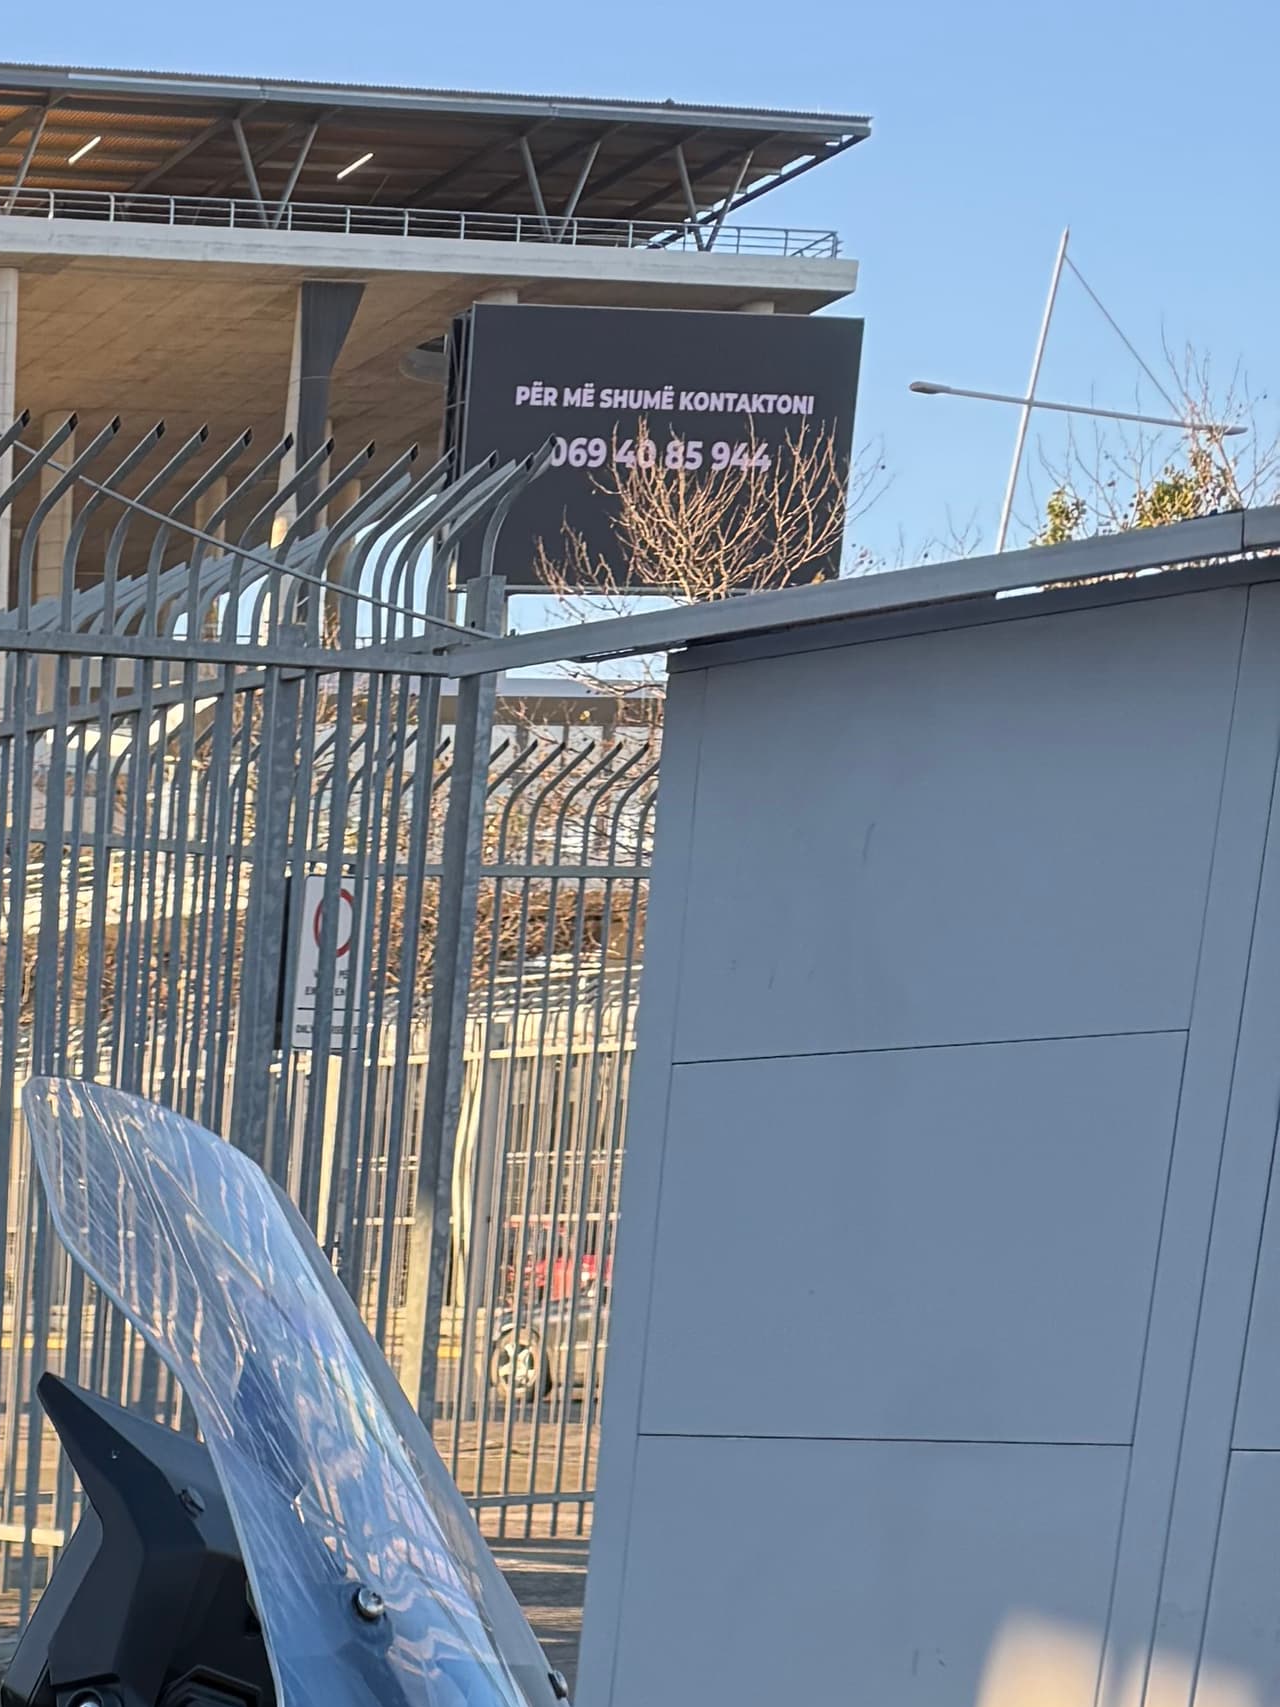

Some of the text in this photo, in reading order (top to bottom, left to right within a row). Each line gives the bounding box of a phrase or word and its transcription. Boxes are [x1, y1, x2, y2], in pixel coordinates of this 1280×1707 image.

[515, 381, 815, 415] PËR MË SHUMË KONTAKTONI
[551, 436, 607, 469] 069
[616, 439, 656, 470] 40
[665, 440, 703, 471] 85
